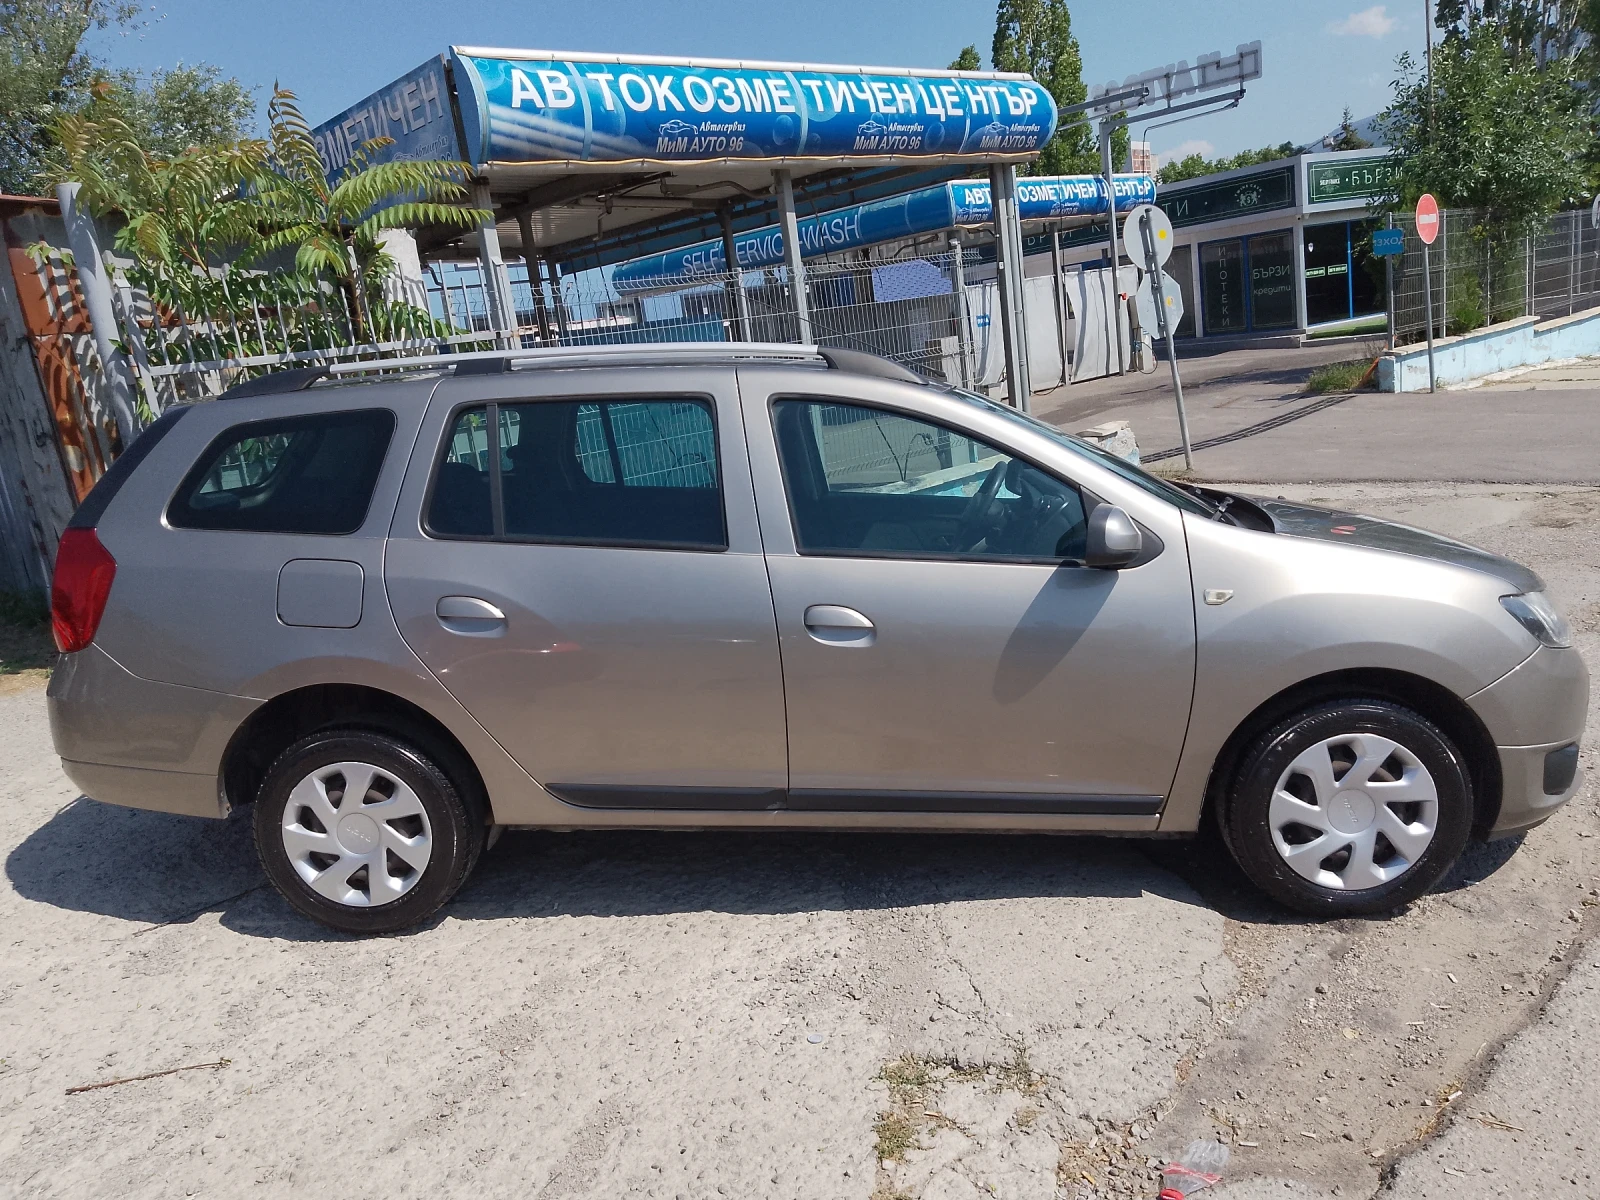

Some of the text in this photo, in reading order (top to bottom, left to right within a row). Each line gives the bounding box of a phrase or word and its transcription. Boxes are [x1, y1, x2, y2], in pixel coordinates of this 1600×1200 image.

[511, 69, 1038, 122] АВТОКОЗМЕТИЧЕН ЦЕНТЪР
[728, 136, 744, 152] 96
[908, 135, 921, 149] 96
[1025, 135, 1038, 148] 96
[1252, 264, 1290, 280] БЪРЗИ
[1218, 246, 1230, 327] ИПОТЕКИ
